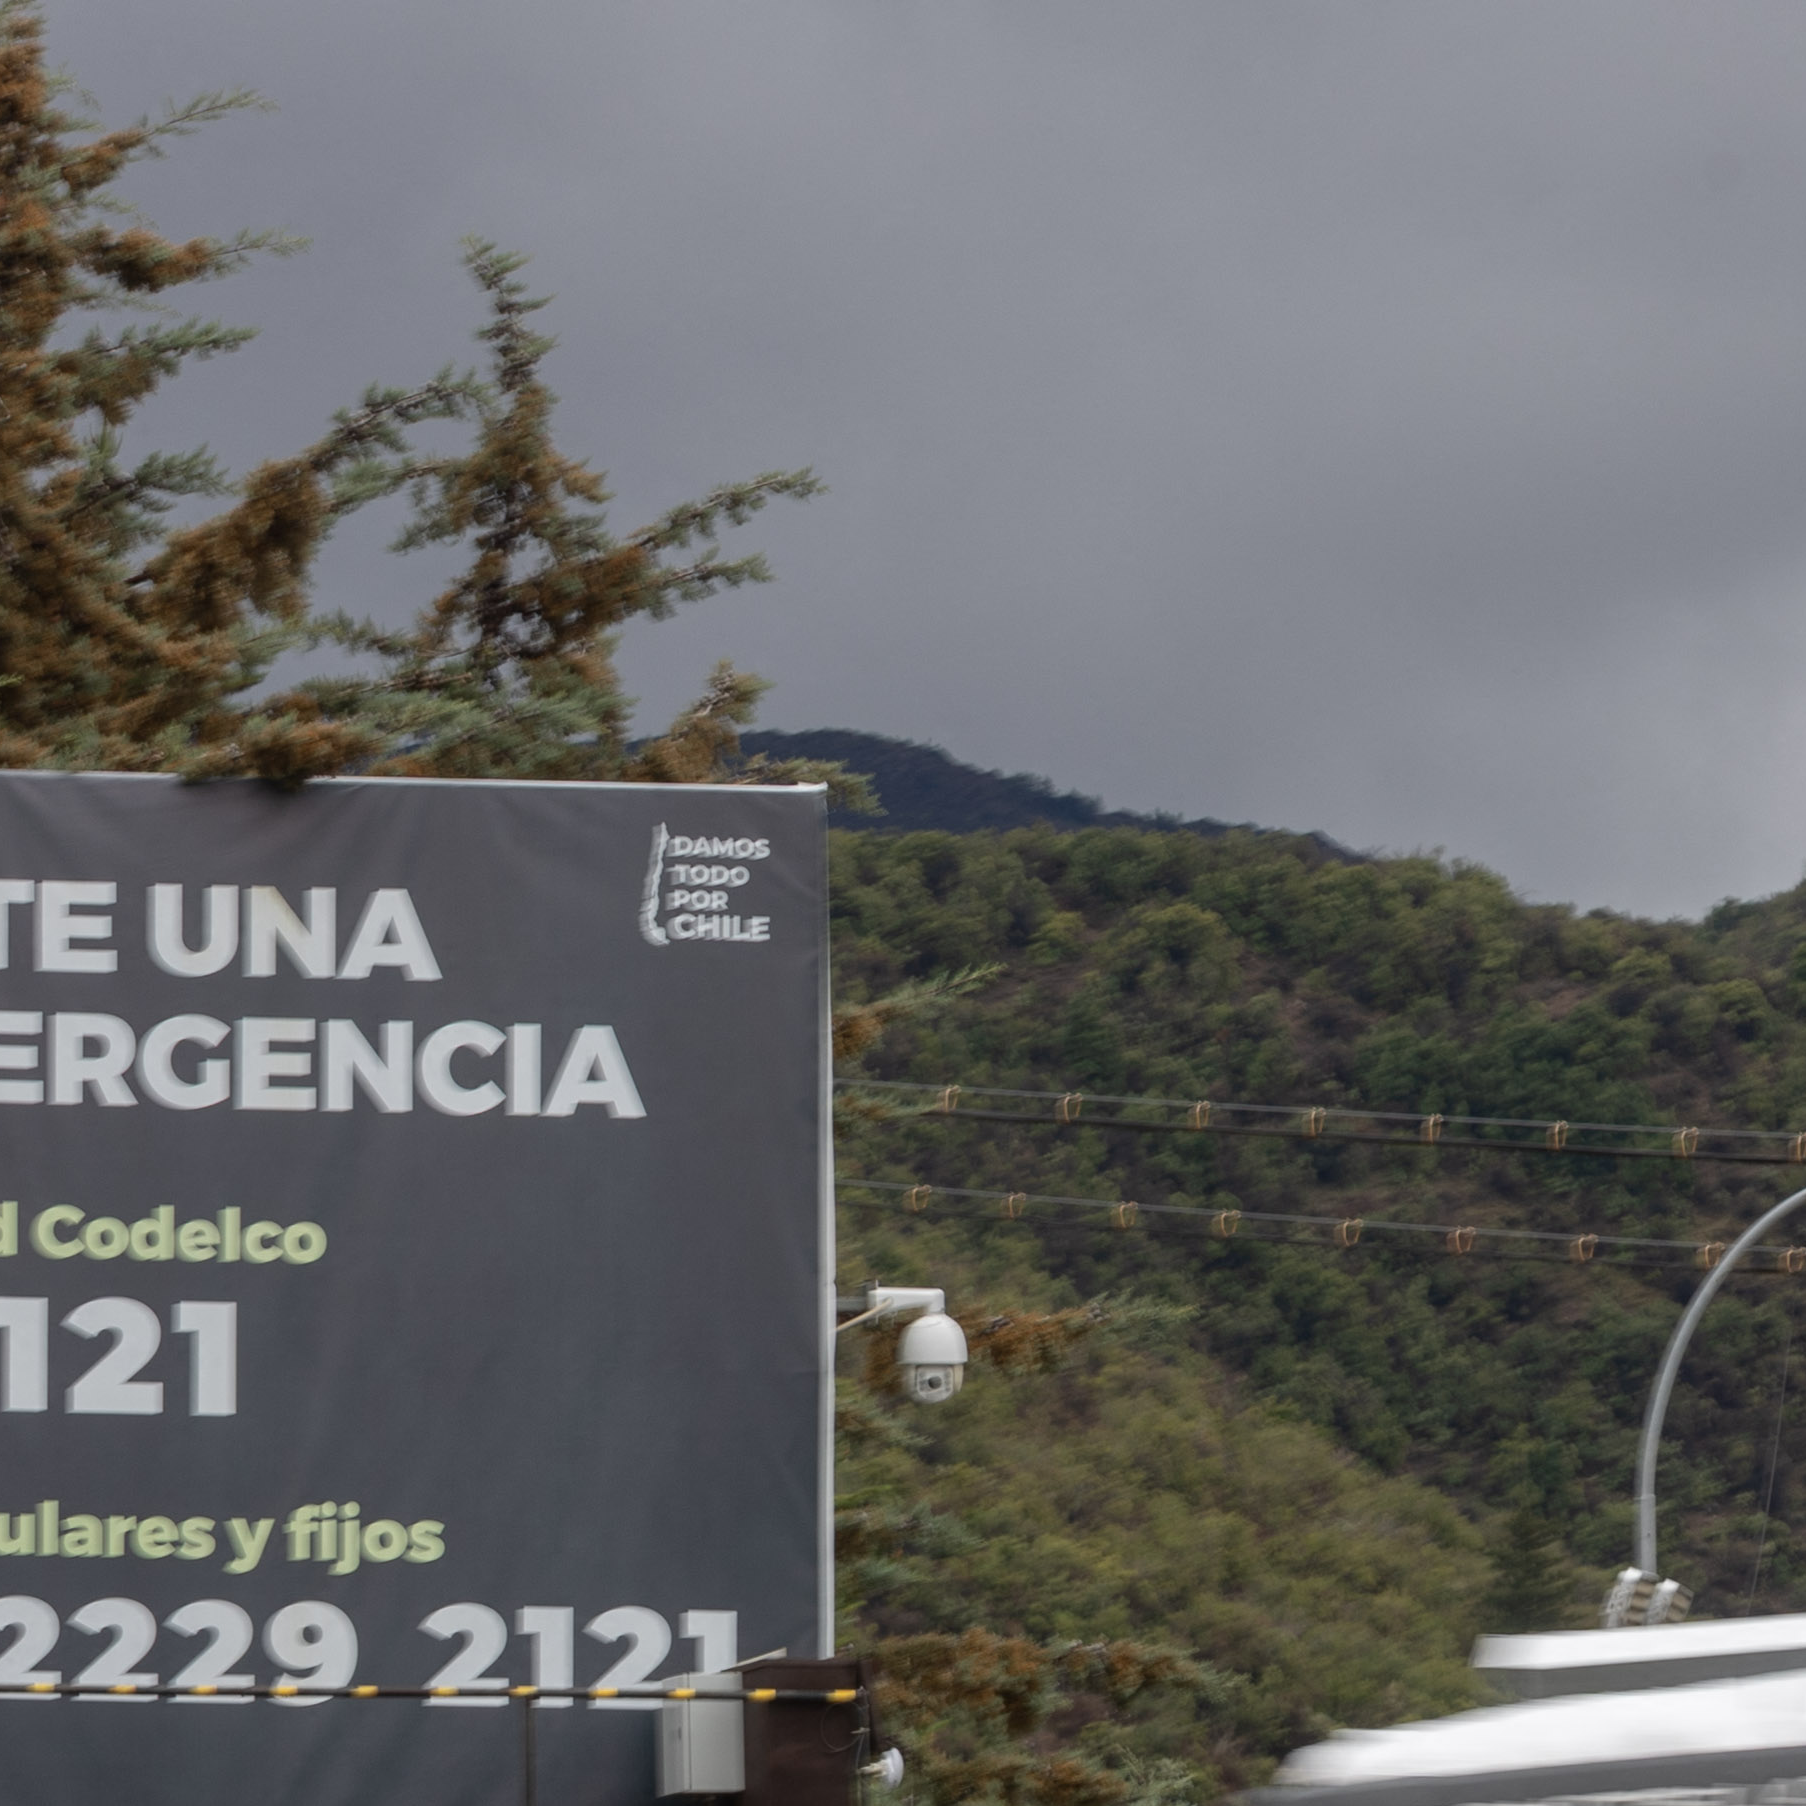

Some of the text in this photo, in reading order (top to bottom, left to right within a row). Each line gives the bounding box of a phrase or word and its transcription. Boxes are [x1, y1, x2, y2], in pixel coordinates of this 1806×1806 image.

[666, 836, 771, 860] DAMOS
[666, 864, 751, 888] TODO
[666, 889, 729, 911] POR
[147, 882, 442, 981] UNA
[665, 913, 771, 942] CHILE
[31, 1204, 328, 1265] Codelco
[223, 1517, 275, 1575] y
[284, 1500, 446, 1576] fijos
[416, 1601, 739, 1709] 2121
